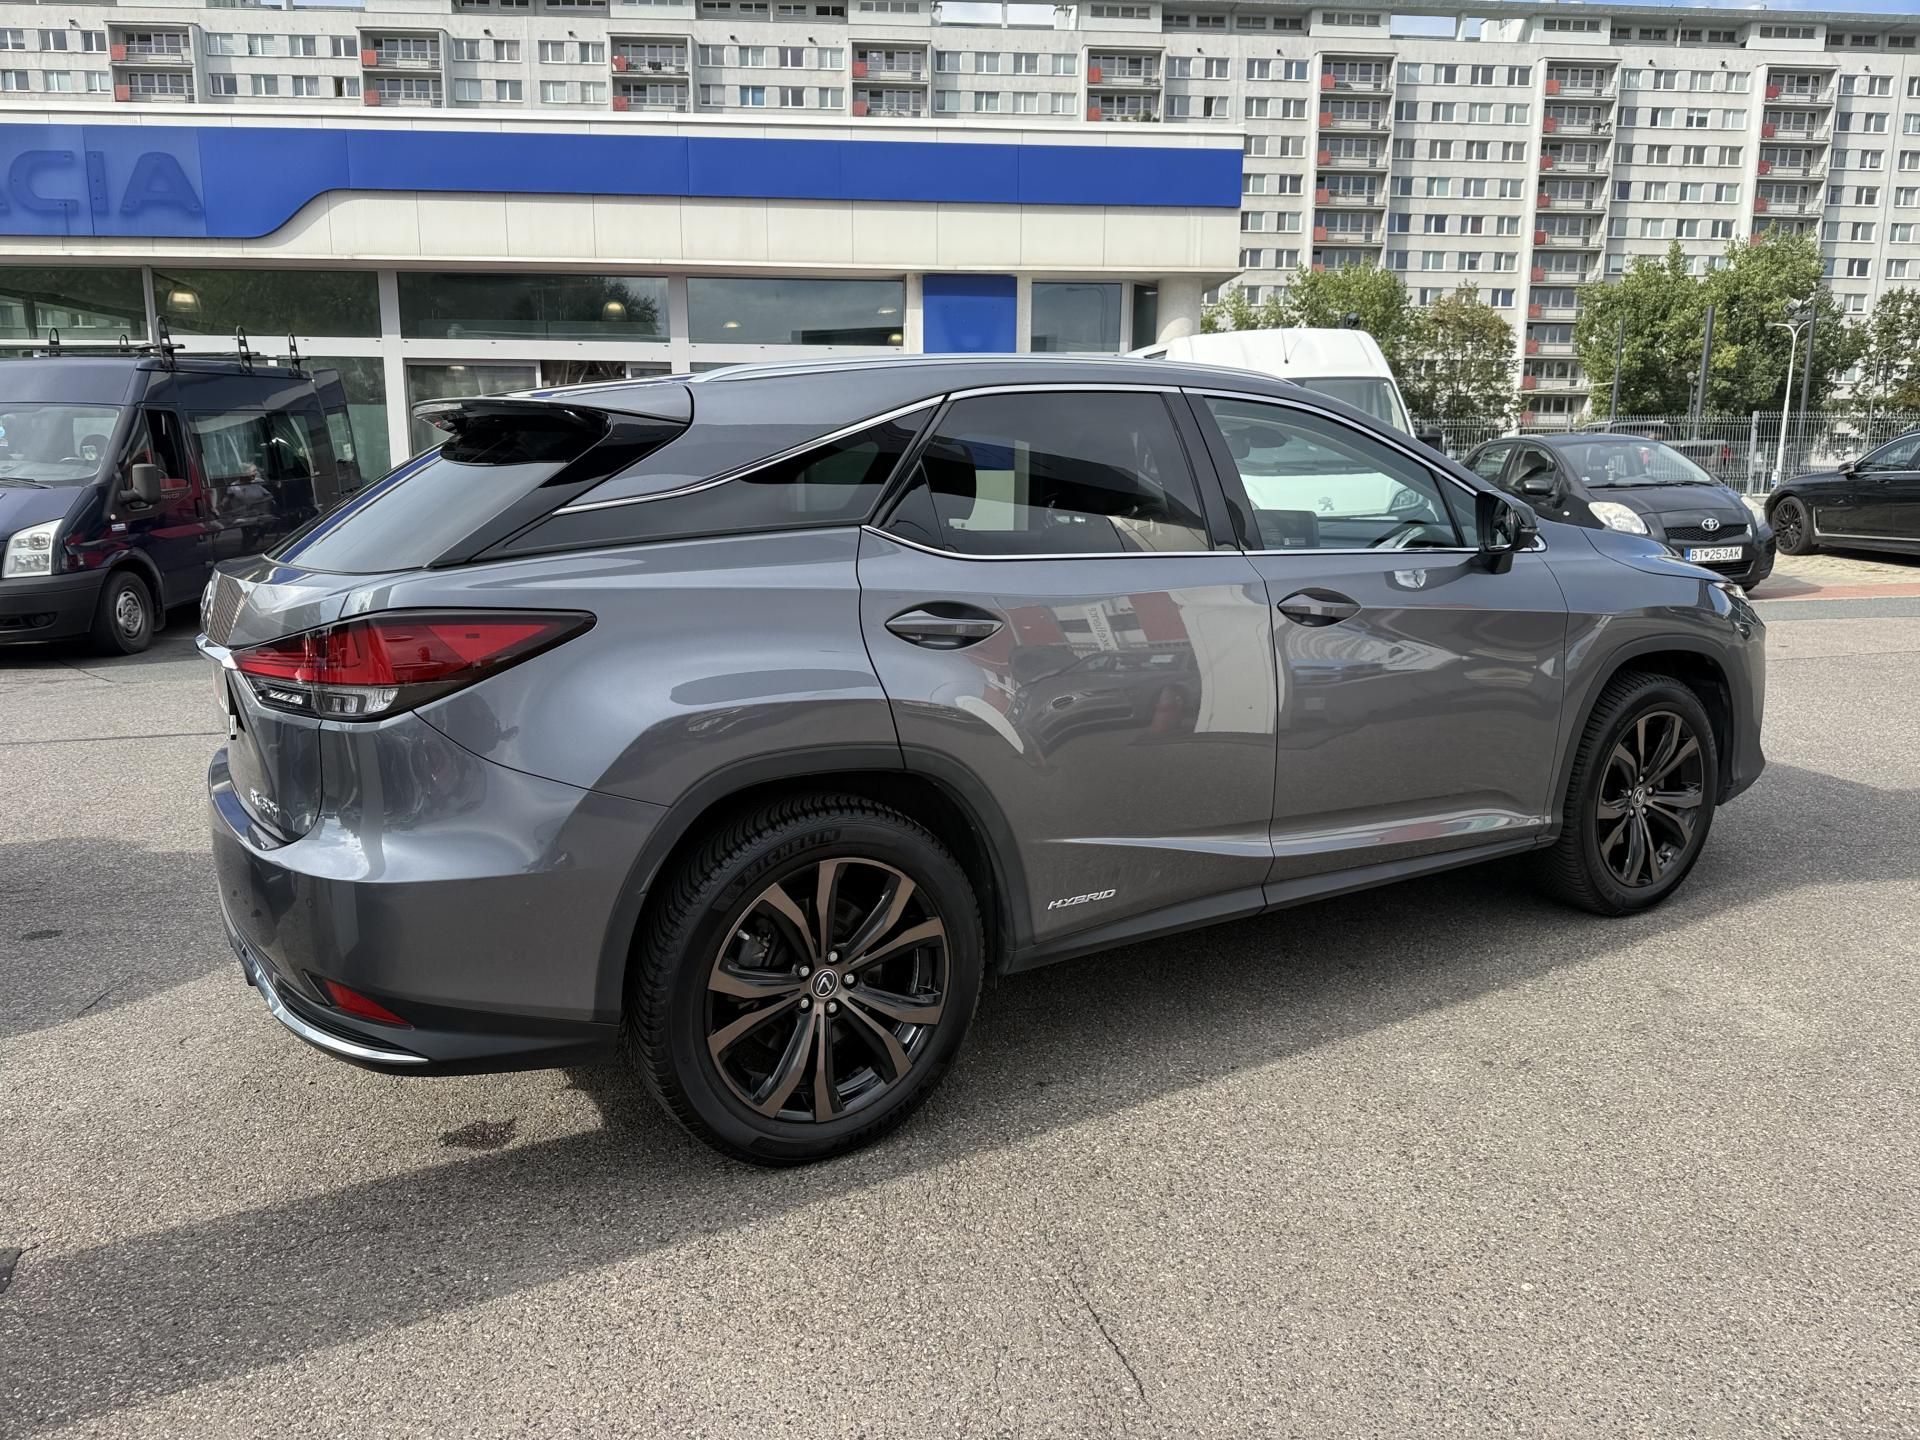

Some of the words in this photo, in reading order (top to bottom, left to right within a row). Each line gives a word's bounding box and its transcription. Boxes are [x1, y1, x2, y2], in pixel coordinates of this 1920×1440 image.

[0, 149, 203, 215] CIA
[745, 829, 836, 882] MICHELIN
[1047, 889, 1117, 910] HYBRID
